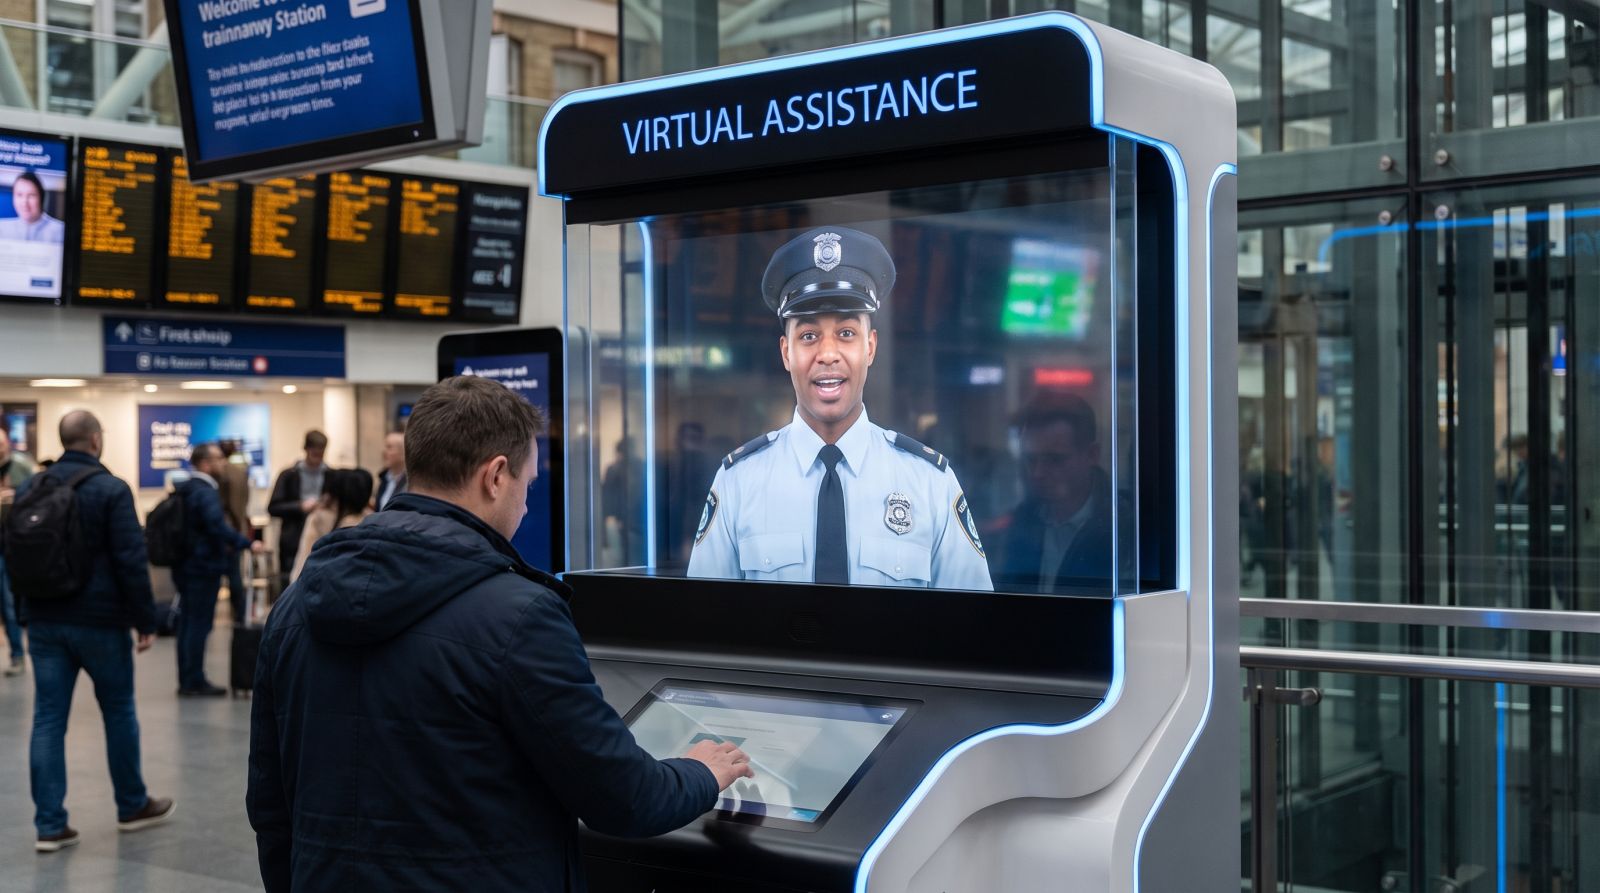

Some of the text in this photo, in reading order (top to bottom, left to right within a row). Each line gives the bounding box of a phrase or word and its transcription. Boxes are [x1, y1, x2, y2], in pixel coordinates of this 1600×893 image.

[198, 0, 260, 22] Welcome
[275, 3, 327, 30] Station
[342, 73, 363, 90] your
[623, 69, 979, 154] VIRTUAL ASSISTANCE
